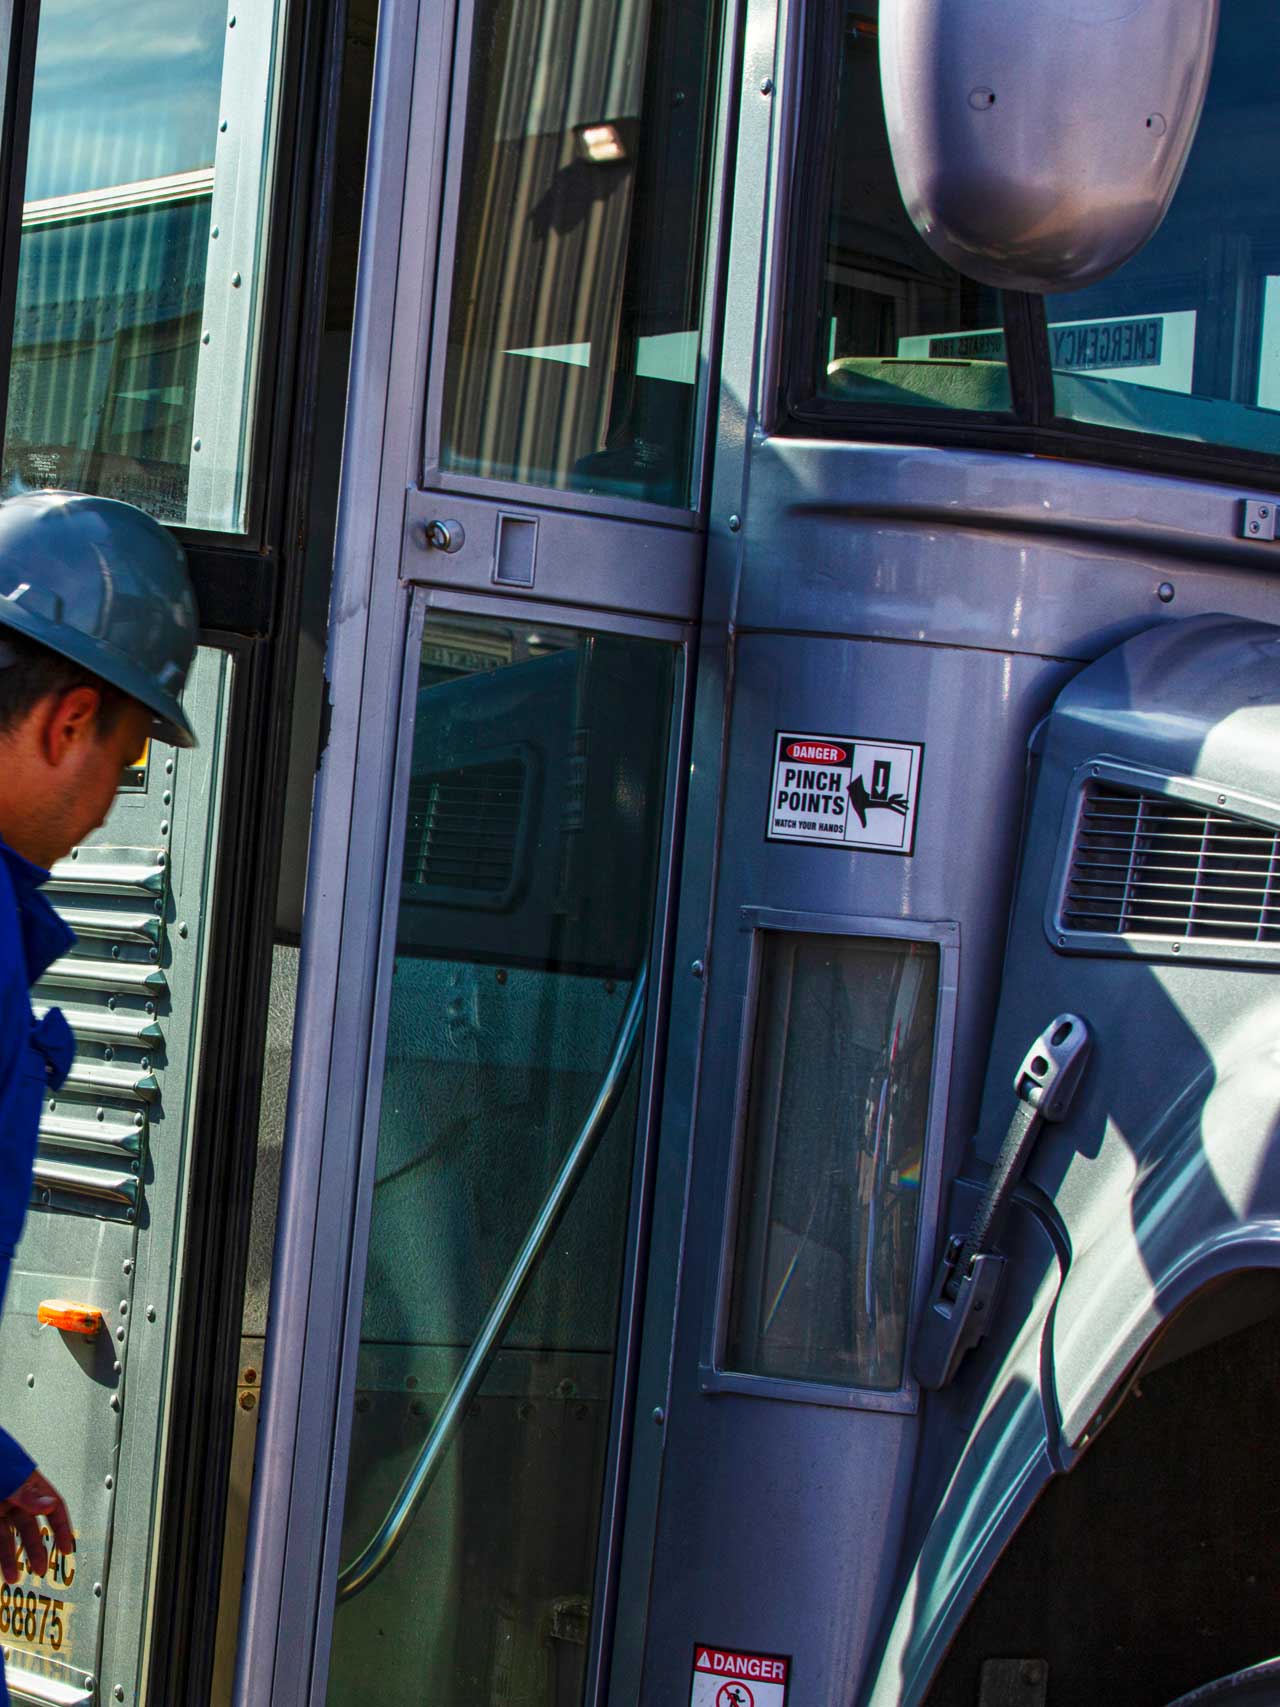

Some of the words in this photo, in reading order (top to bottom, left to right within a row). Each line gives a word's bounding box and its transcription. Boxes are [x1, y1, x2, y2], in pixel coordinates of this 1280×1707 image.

[793, 745, 838, 761] DANGER
[784, 768, 842, 792] PINCH
[777, 790, 845, 815] POINTS
[775, 818, 797, 829] WATCH
[798, 820, 817, 831] YOUR
[818, 822, 844, 834] HANDS
[713, 1653, 785, 1679] DANGER
